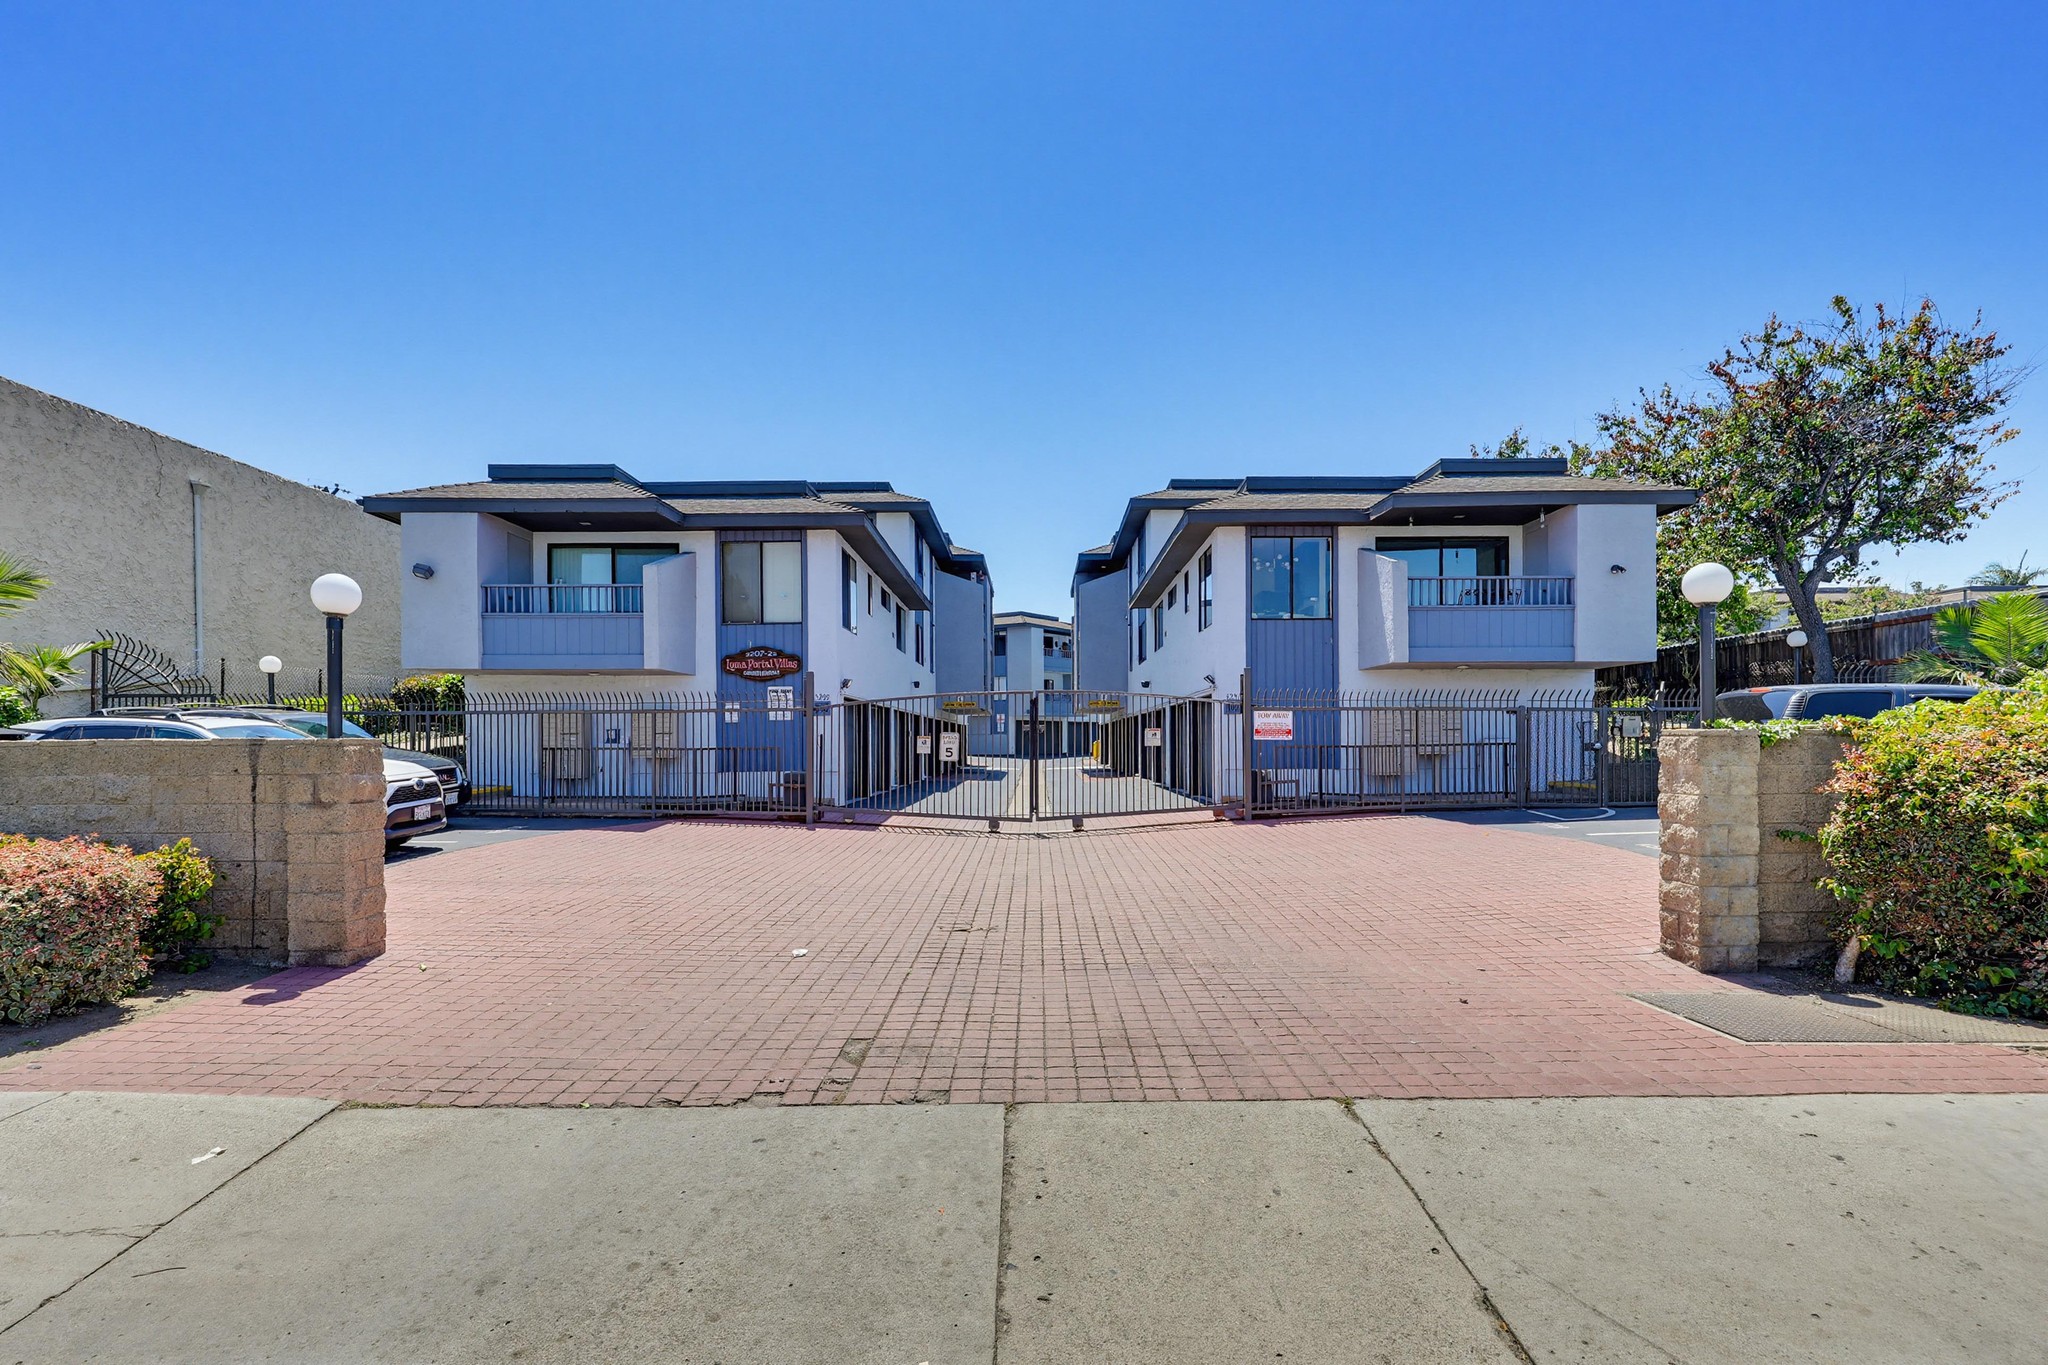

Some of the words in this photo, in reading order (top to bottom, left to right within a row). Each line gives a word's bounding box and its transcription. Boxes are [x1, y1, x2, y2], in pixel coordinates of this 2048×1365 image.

[748, 659, 774, 670] Portal
[774, 658, 798, 669] Villas
[945, 747, 953, 758] 5
